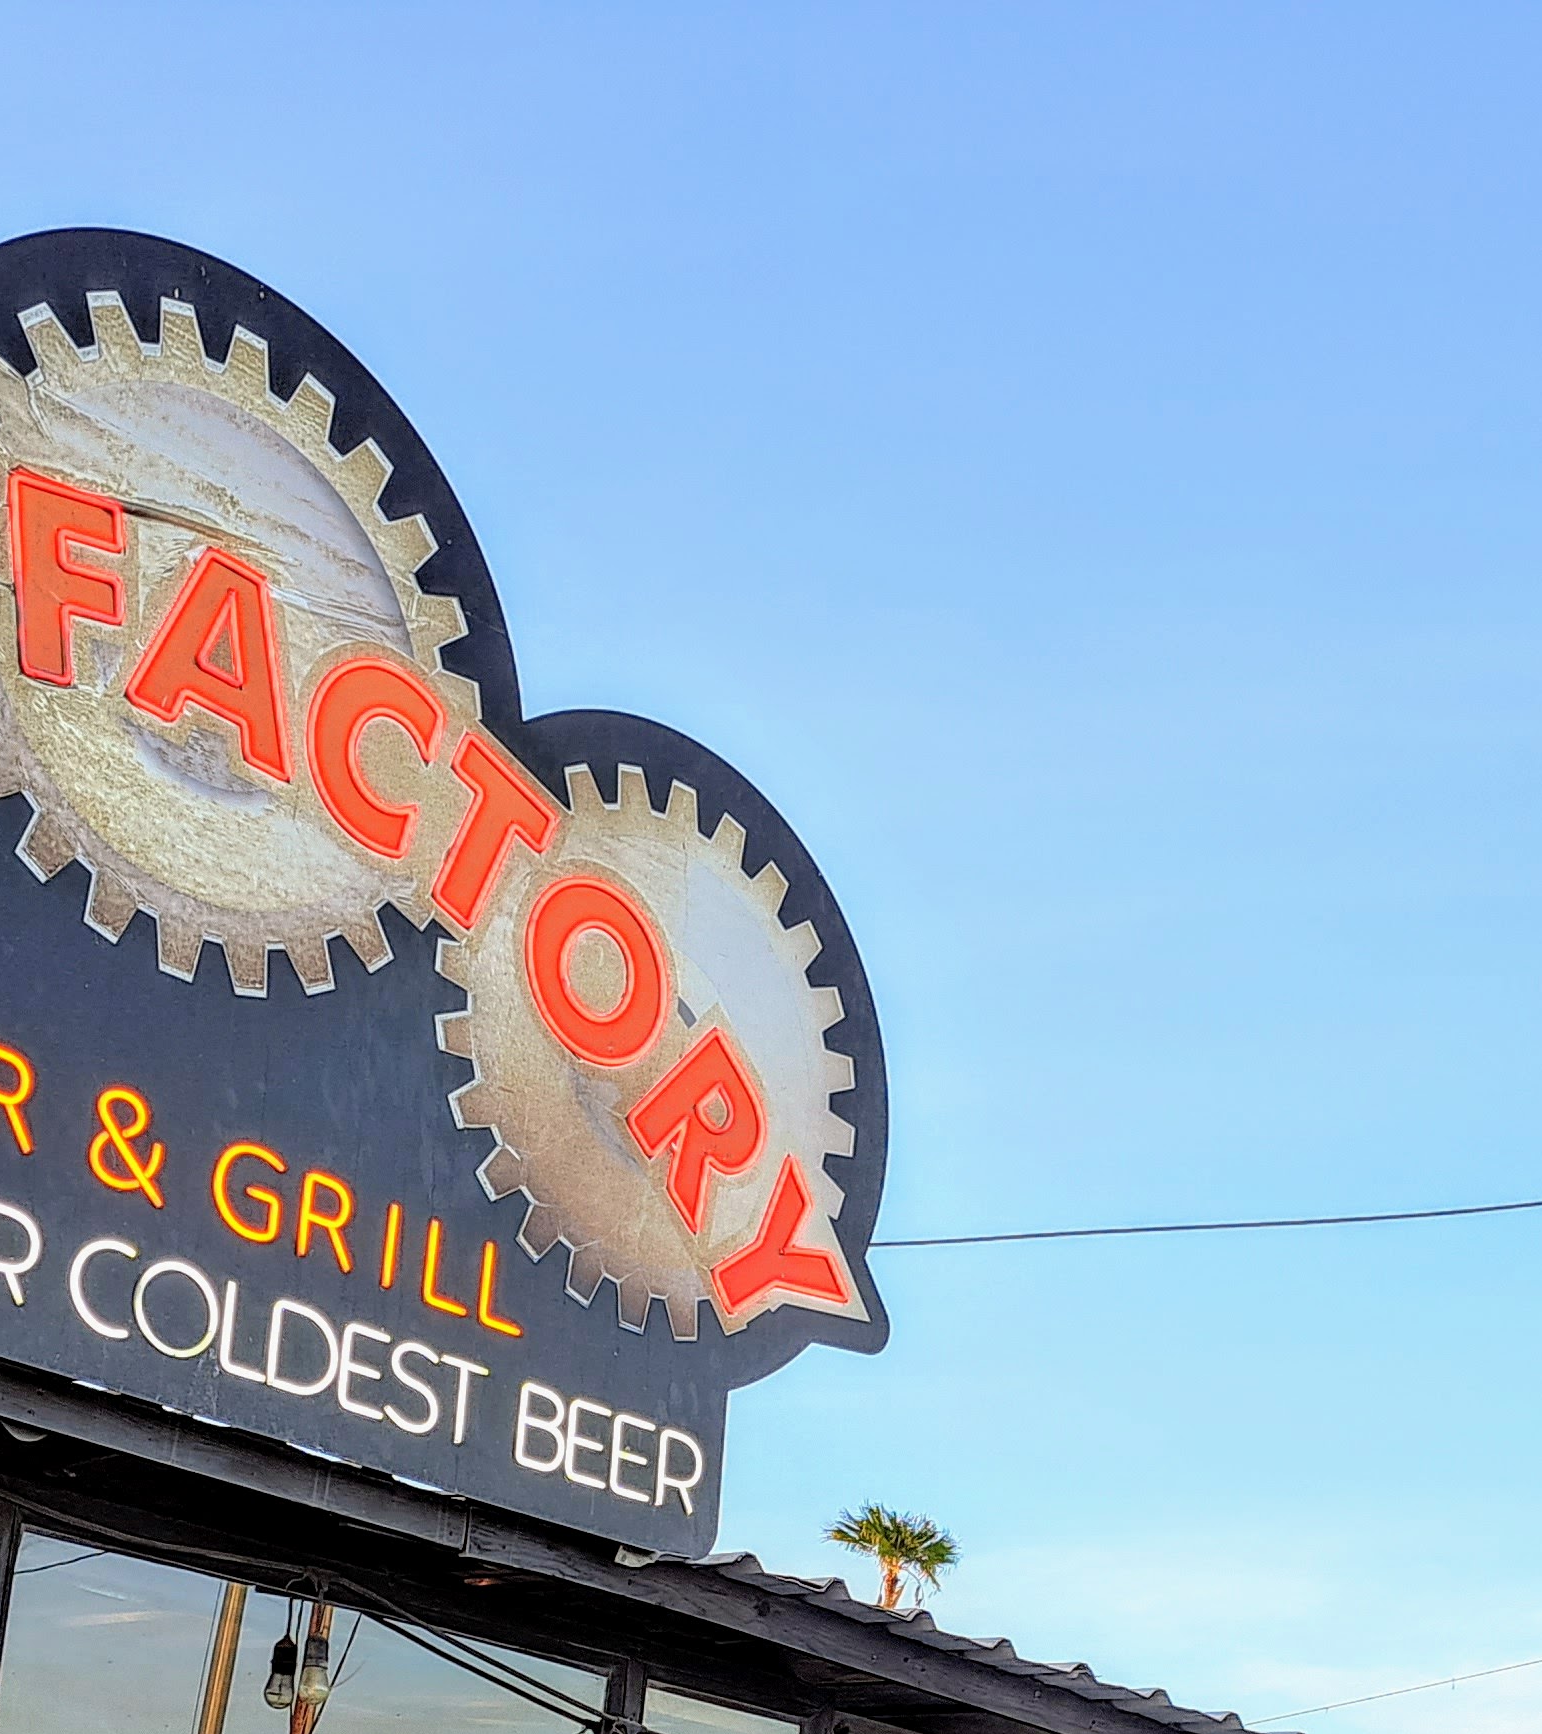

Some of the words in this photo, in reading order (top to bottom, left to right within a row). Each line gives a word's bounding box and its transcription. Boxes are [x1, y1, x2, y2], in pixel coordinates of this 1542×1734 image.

[9, 468, 848, 1316] FACTORY
[87, 1085, 166, 1209] &
[211, 1140, 523, 1338] GRILL
[67, 1238, 489, 1446] COLDEST
[511, 1381, 705, 1516] BEER
